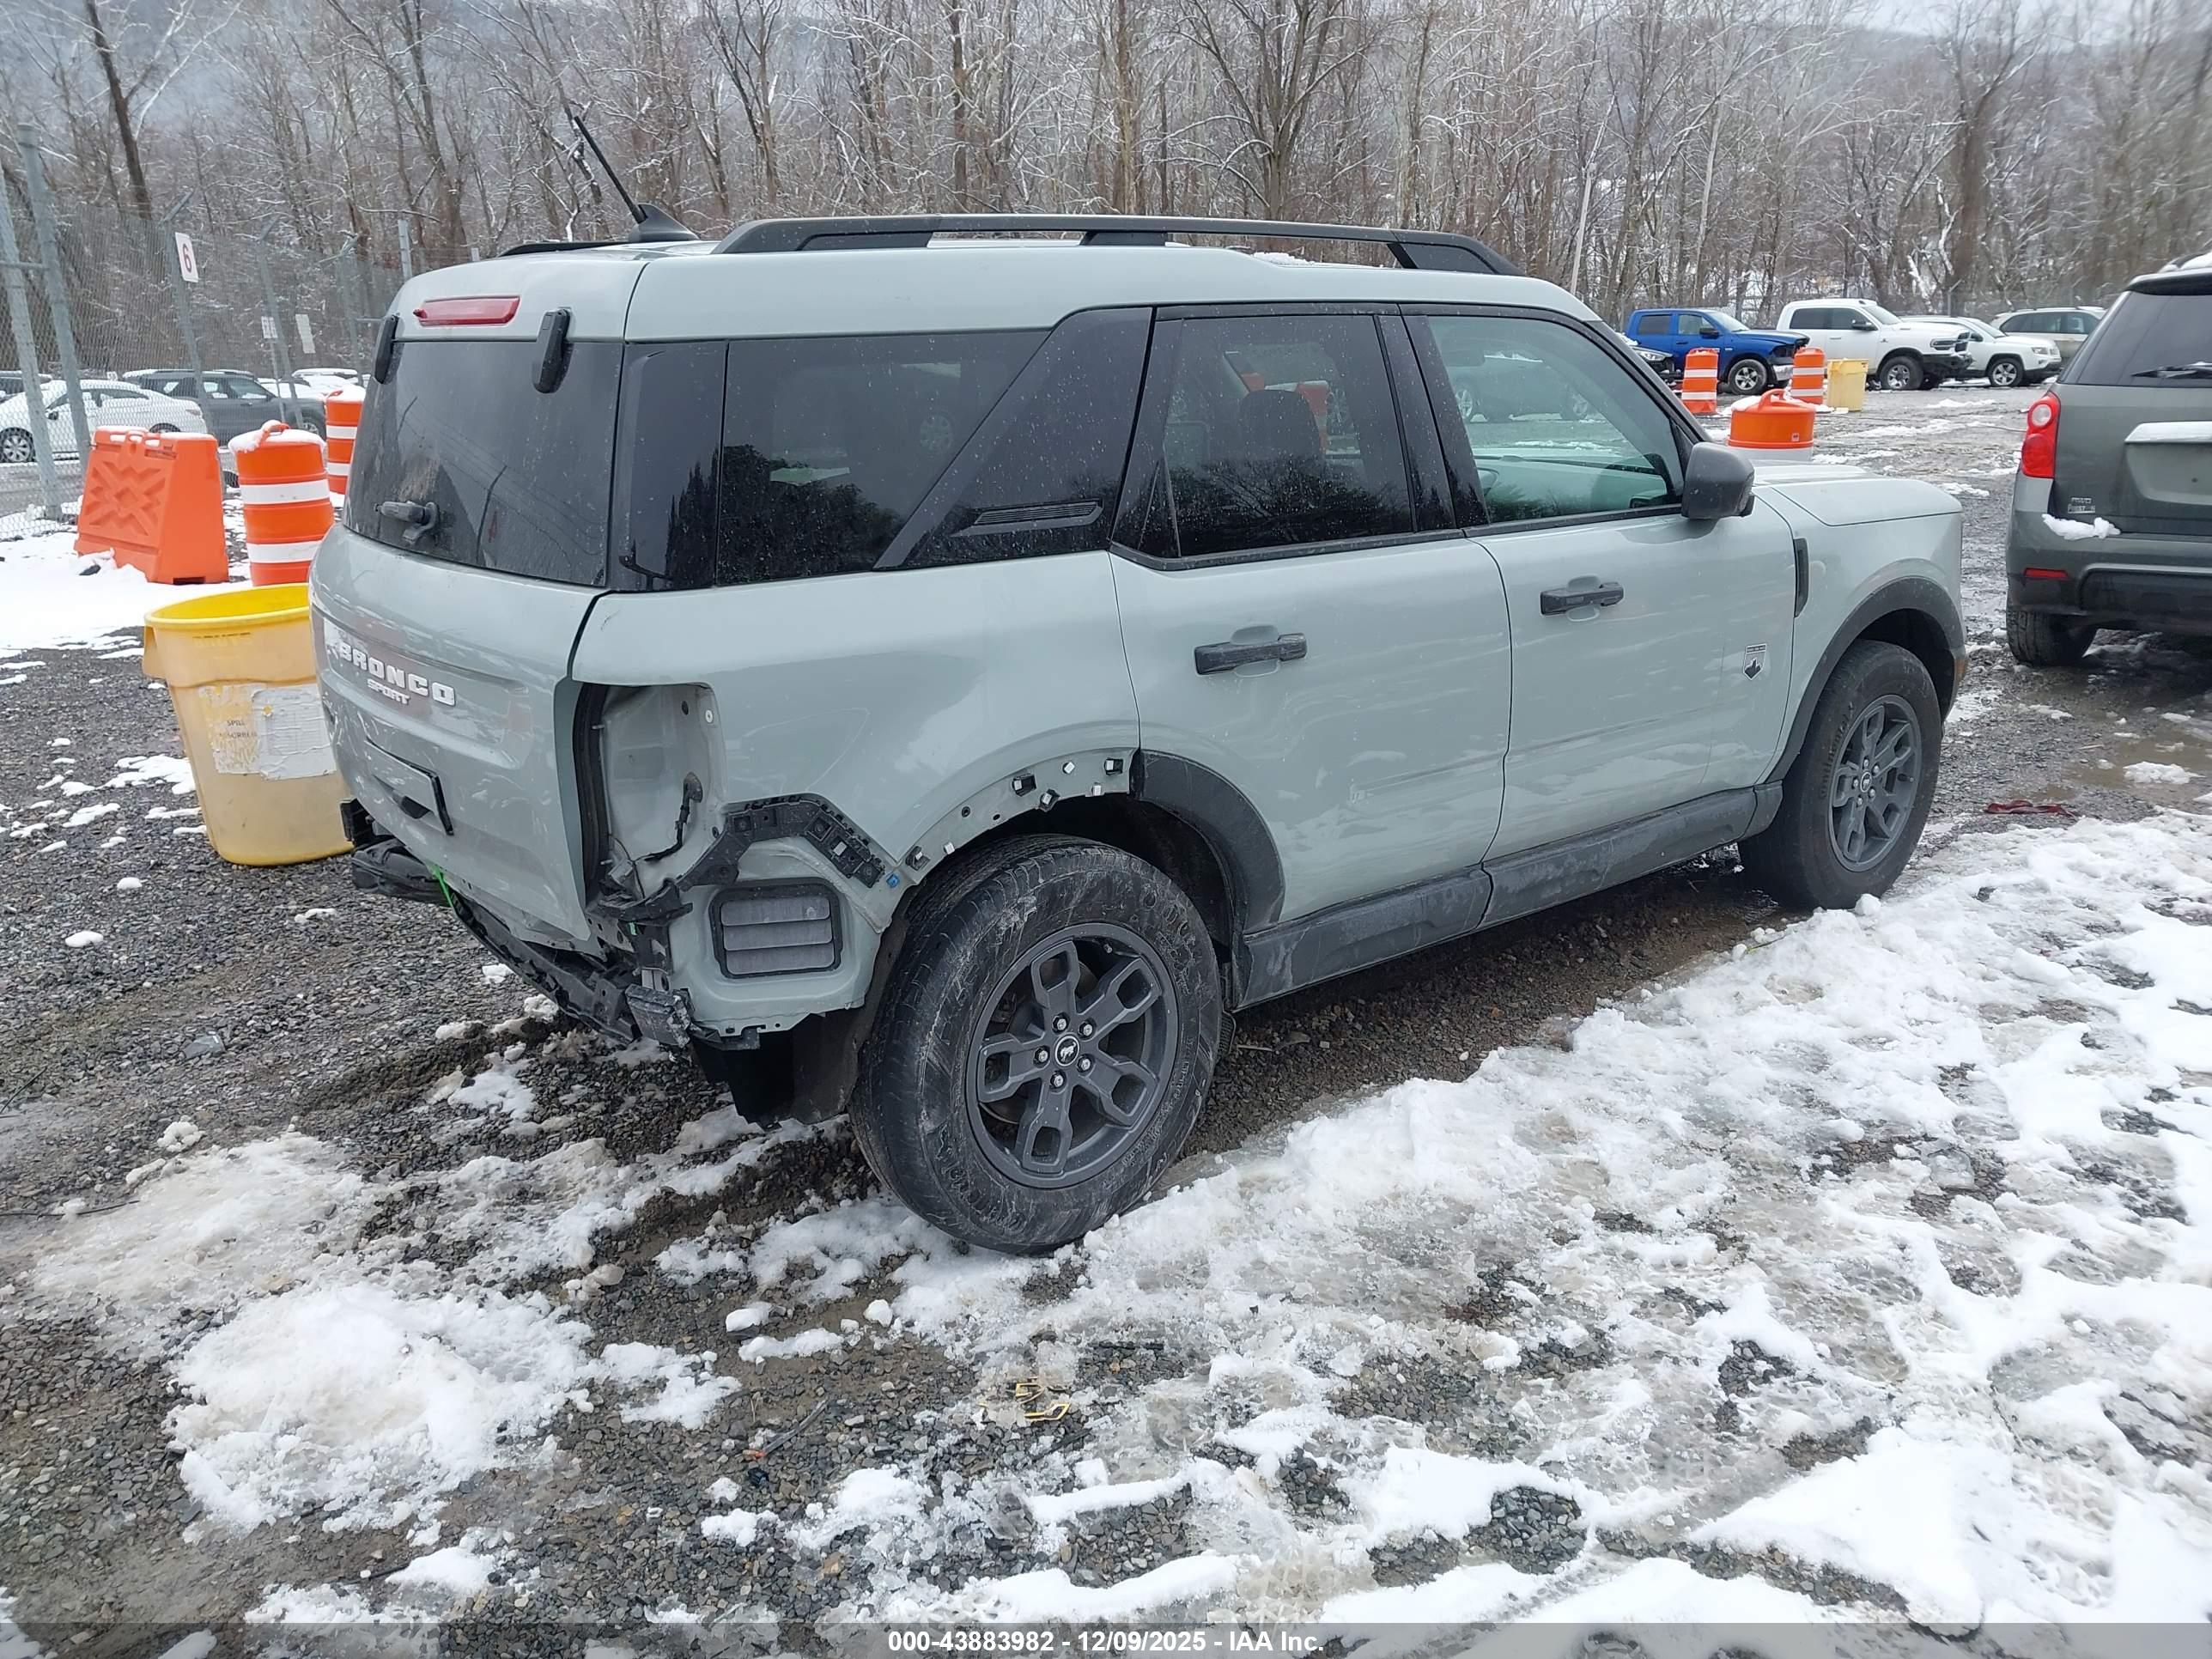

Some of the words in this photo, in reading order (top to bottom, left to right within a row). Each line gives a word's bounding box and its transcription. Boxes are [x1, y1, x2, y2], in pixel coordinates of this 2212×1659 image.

[183, 243, 192, 273] 6
[337, 641, 455, 706] BRONCO
[367, 678, 410, 705] SPORT
